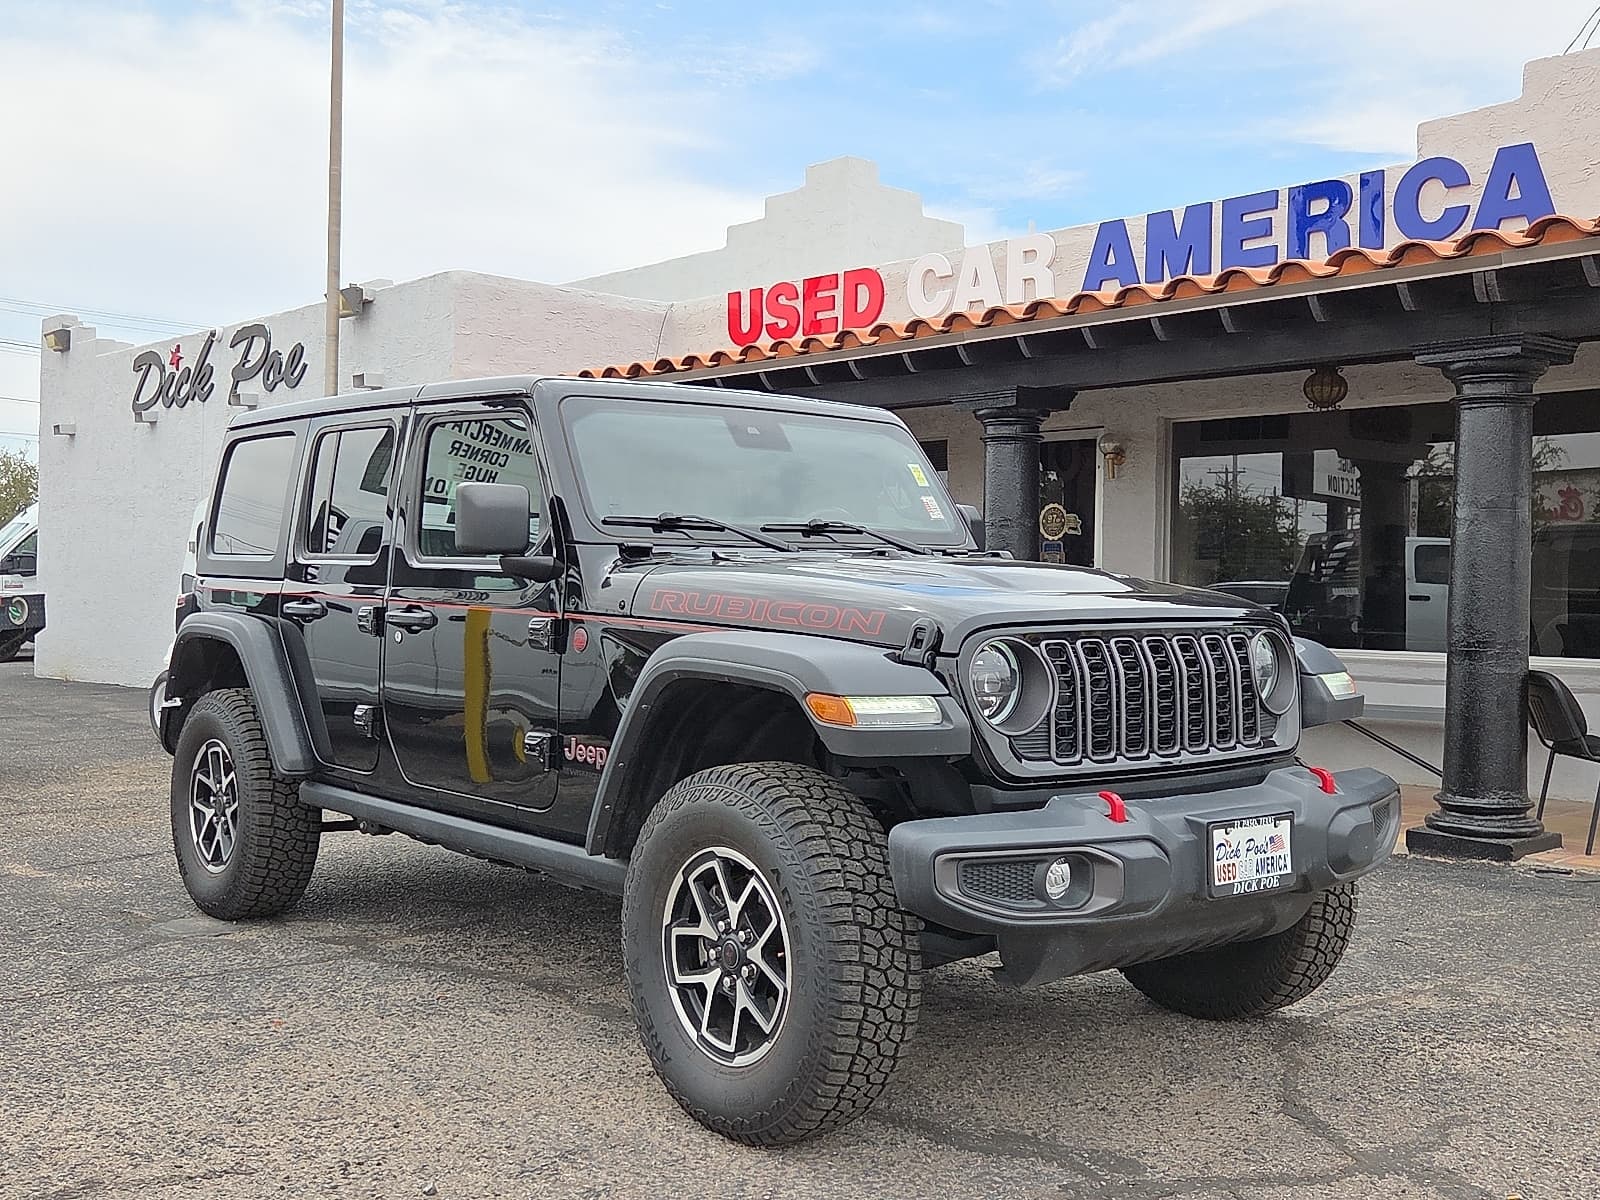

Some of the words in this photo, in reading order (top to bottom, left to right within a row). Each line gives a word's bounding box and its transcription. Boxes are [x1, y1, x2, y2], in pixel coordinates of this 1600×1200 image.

[727, 268, 885, 348] USED
[907, 233, 1056, 318] CAR
[1080, 142, 1557, 292] AMERICA
[132, 329, 216, 412] Dick
[228, 324, 308, 406] Poe
[651, 590, 886, 635] RUBICON
[564, 737, 607, 770] Jeep
[1216, 839, 1241, 862] Dick
[1217, 863, 1237, 883] USED
[1256, 854, 1287, 876] AMERICA
[1232, 881, 1259, 895] DICK
[1260, 876, 1280, 890] POE
